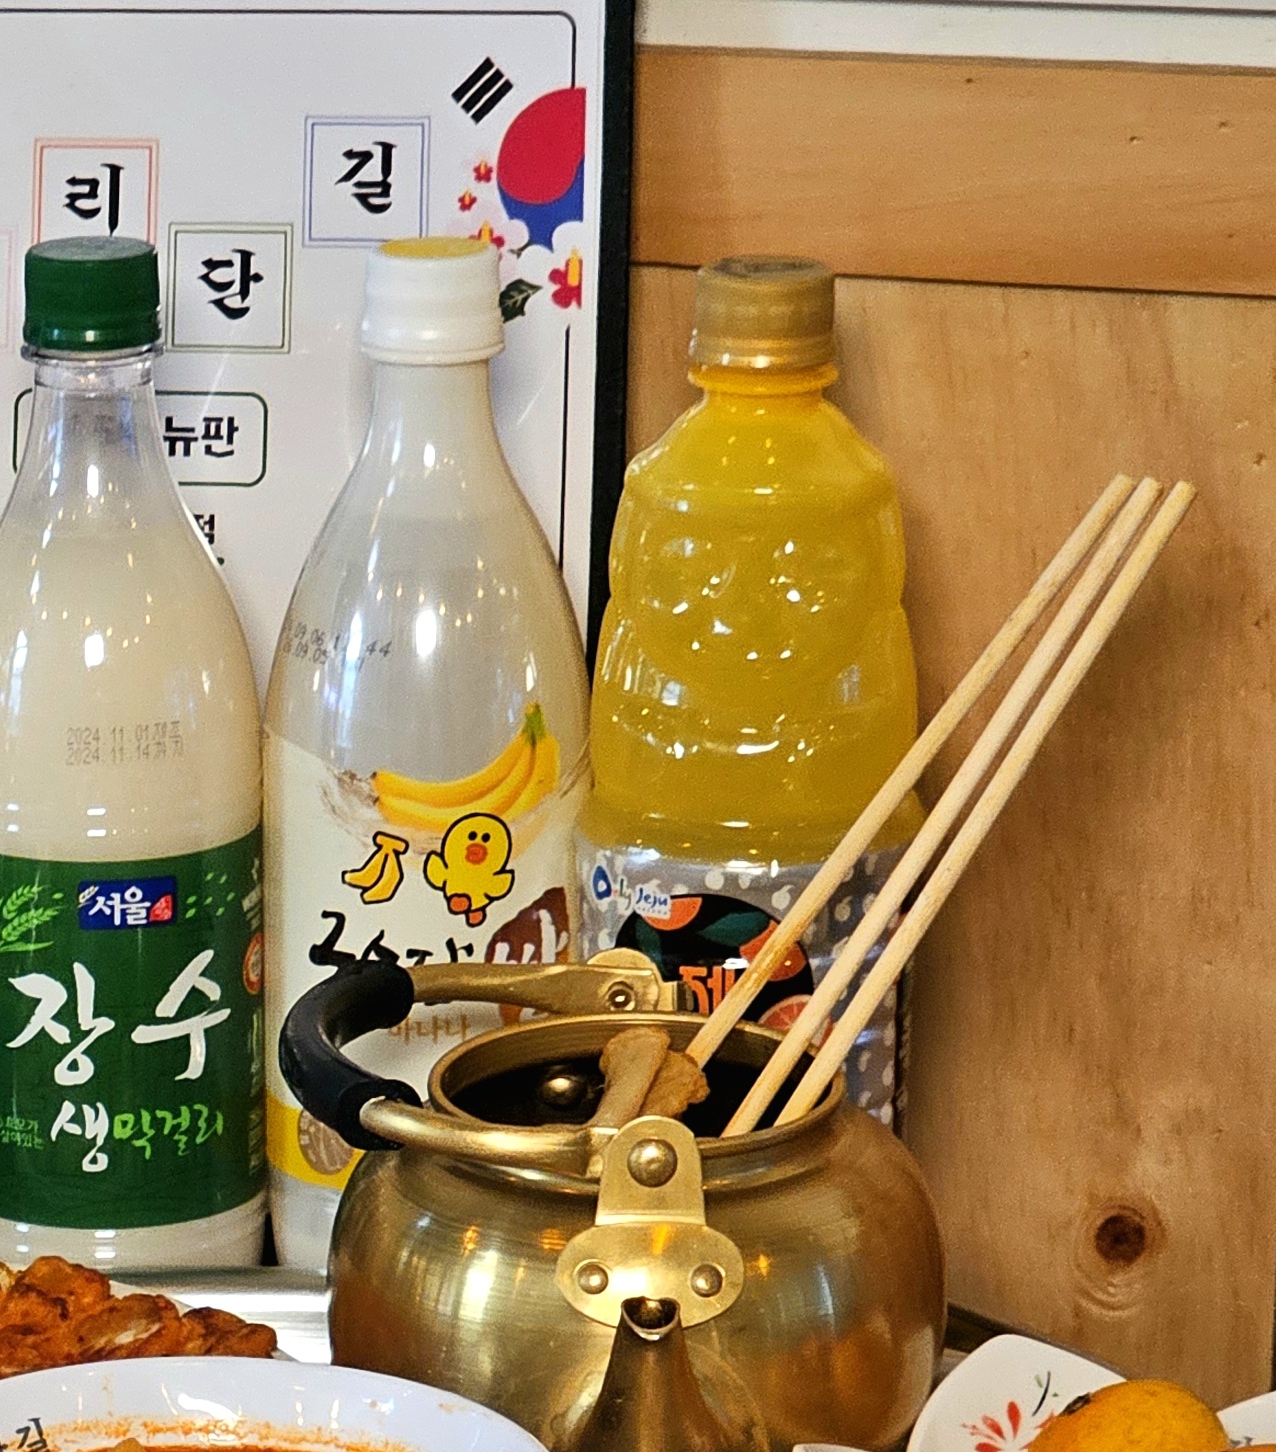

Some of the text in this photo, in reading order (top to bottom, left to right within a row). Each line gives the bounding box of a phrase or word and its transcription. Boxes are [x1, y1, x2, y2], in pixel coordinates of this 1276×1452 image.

[162, 416, 239, 458] 뉴판
[88, 885, 152, 926] 서울
[636, 887, 668, 908] Jeju
[5, 949, 232, 1086] 장수
